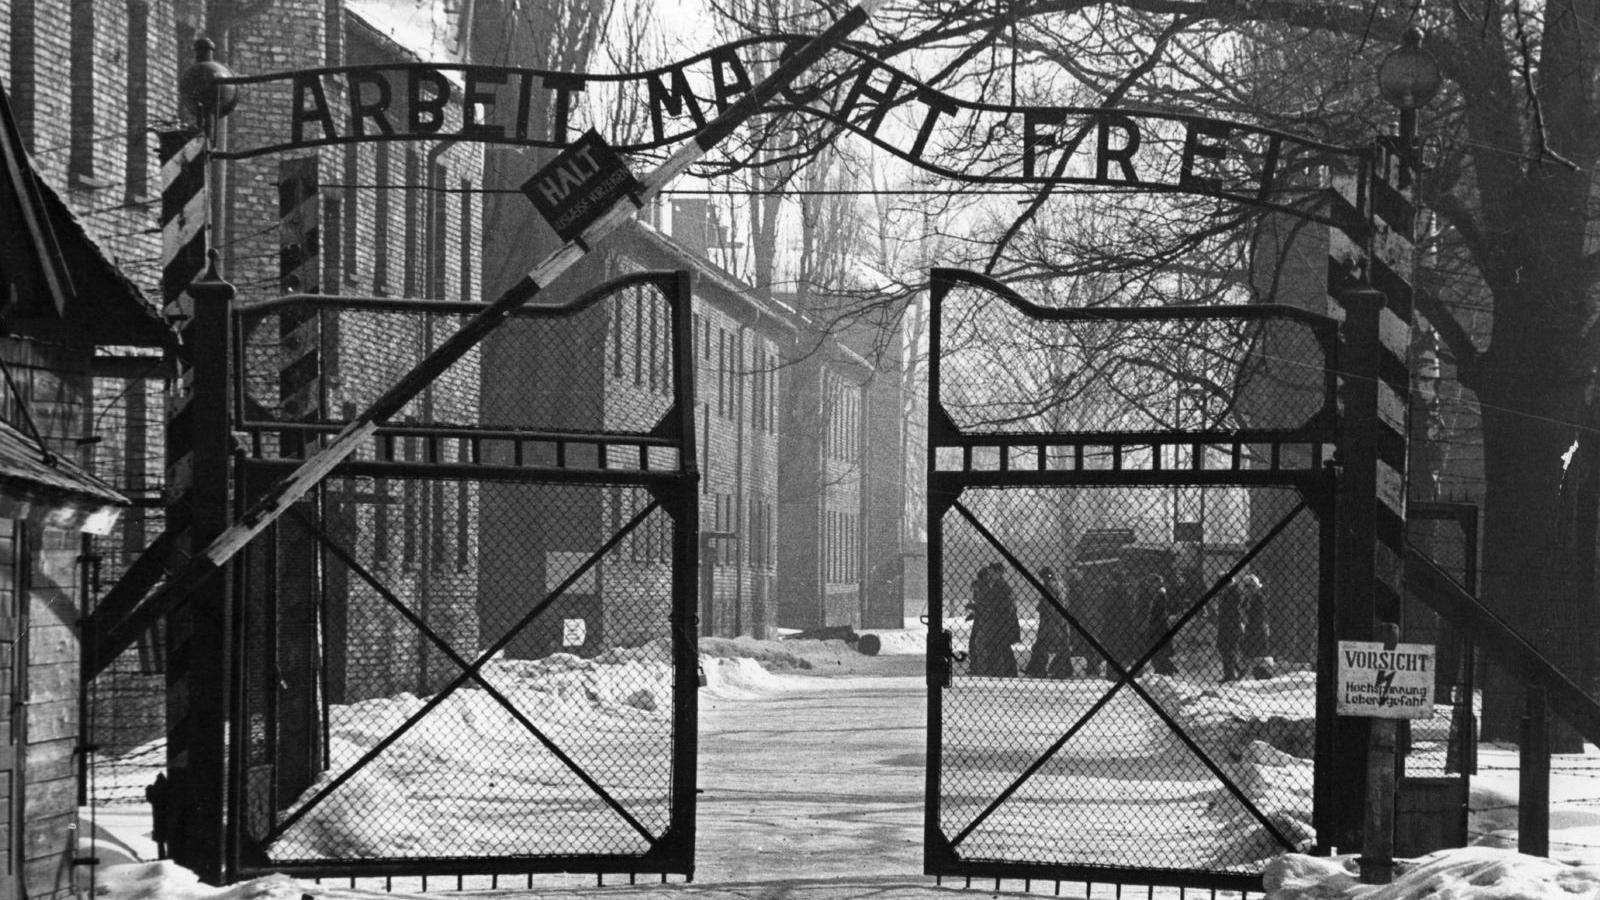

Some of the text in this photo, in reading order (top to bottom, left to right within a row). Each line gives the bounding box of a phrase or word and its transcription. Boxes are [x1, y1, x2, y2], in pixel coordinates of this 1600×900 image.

[291, 66, 586, 143] ARBEIT
[1023, 110, 1281, 202] FREI
[537, 144, 600, 206] HALT
[1345, 650, 1429, 672] VORSICHT
[1345, 693, 1427, 708] Lebengefahr
